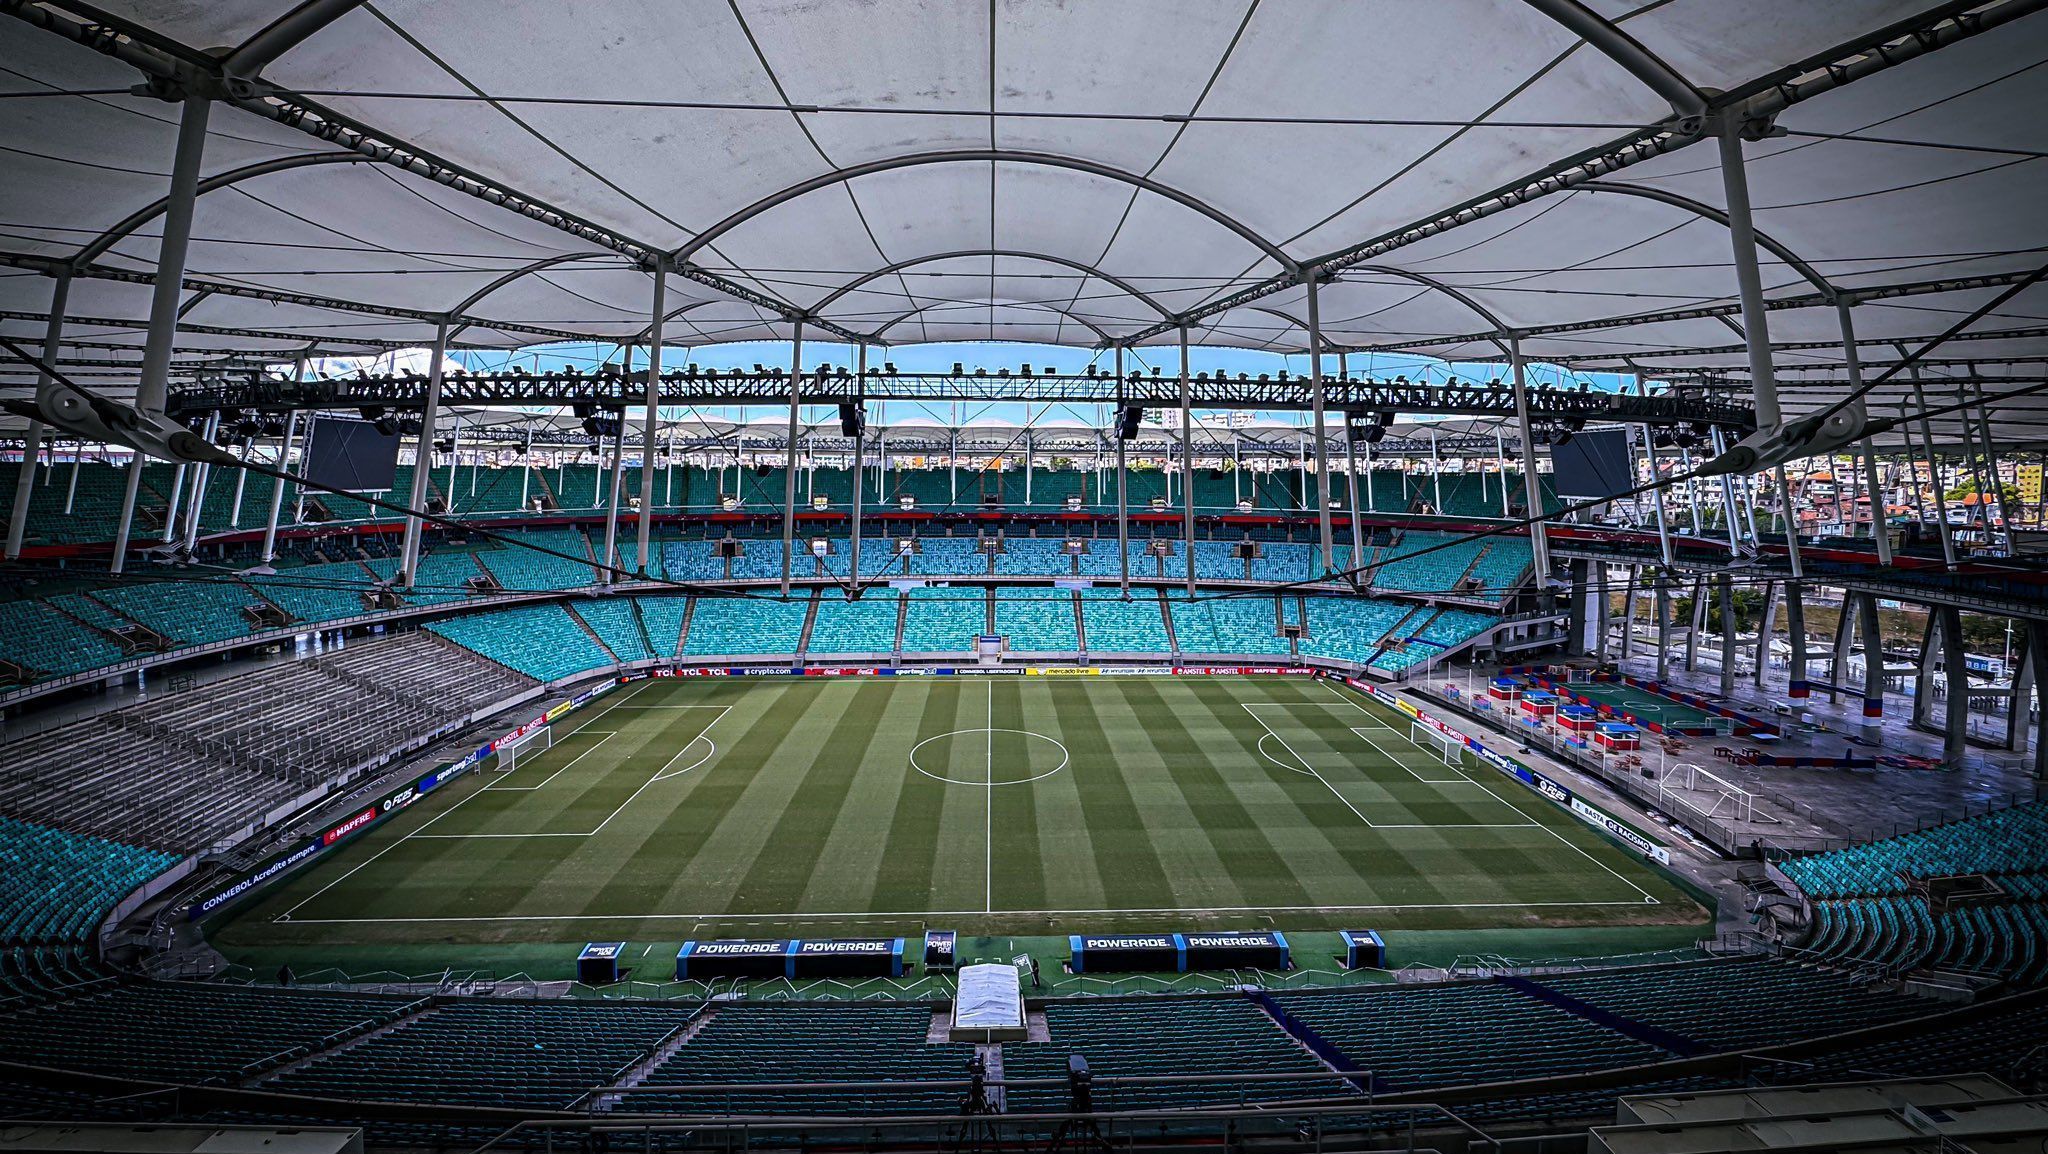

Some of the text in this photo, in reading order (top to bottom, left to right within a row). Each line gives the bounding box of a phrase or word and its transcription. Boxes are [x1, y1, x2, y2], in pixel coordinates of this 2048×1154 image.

[682, 668, 702, 676] TCL
[708, 668, 727, 676] TCL
[436, 752, 477, 781] sportingbet
[1482, 748, 1517, 774] sportingbet
[336, 811, 371, 837] MAPFRE
[1584, 807, 1650, 850] BASTA DE RACISMO
[202, 845, 315, 911] CONMEBOL Acredite sempre
